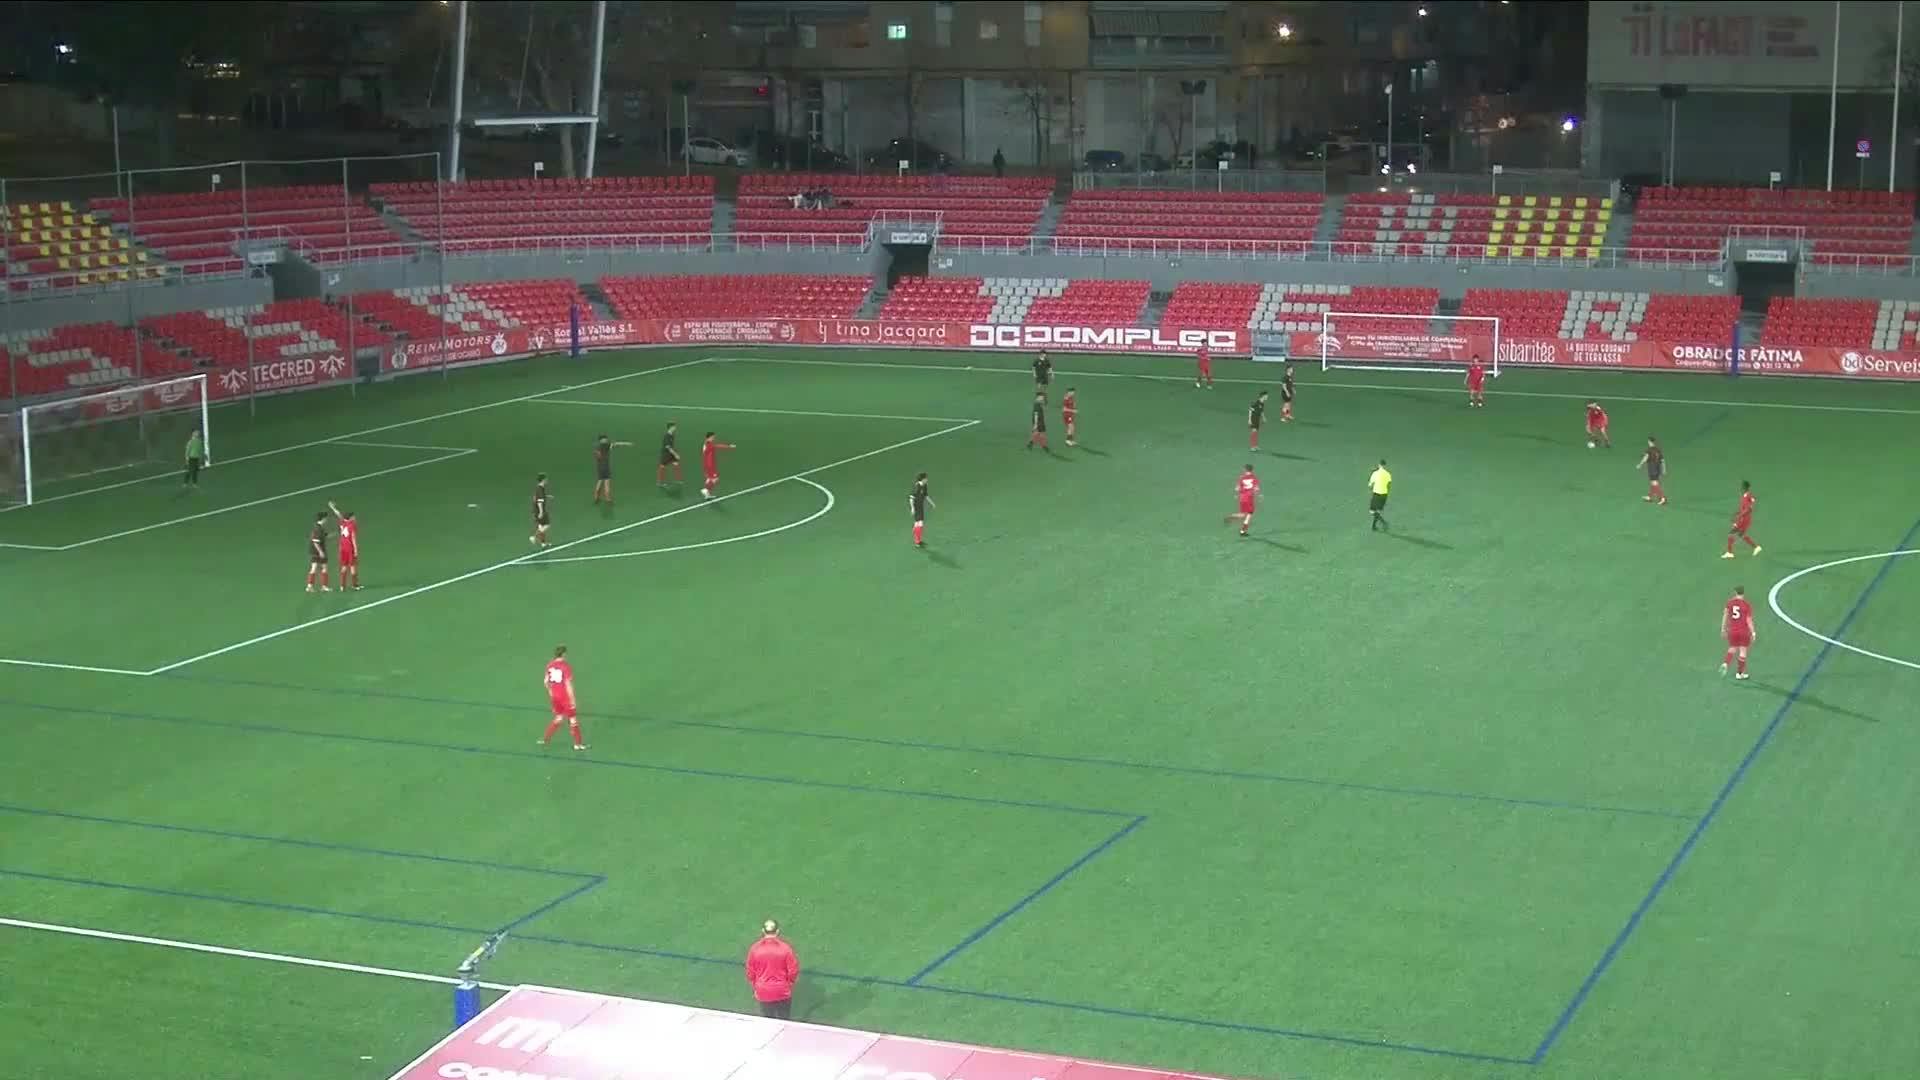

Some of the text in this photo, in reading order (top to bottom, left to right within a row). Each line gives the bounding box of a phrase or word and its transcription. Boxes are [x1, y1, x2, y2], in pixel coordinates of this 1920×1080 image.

[1750, 346, 1803, 362] FÀTIMA
[252, 358, 315, 383] TECFRED
[1732, 605, 1741, 620] 5
